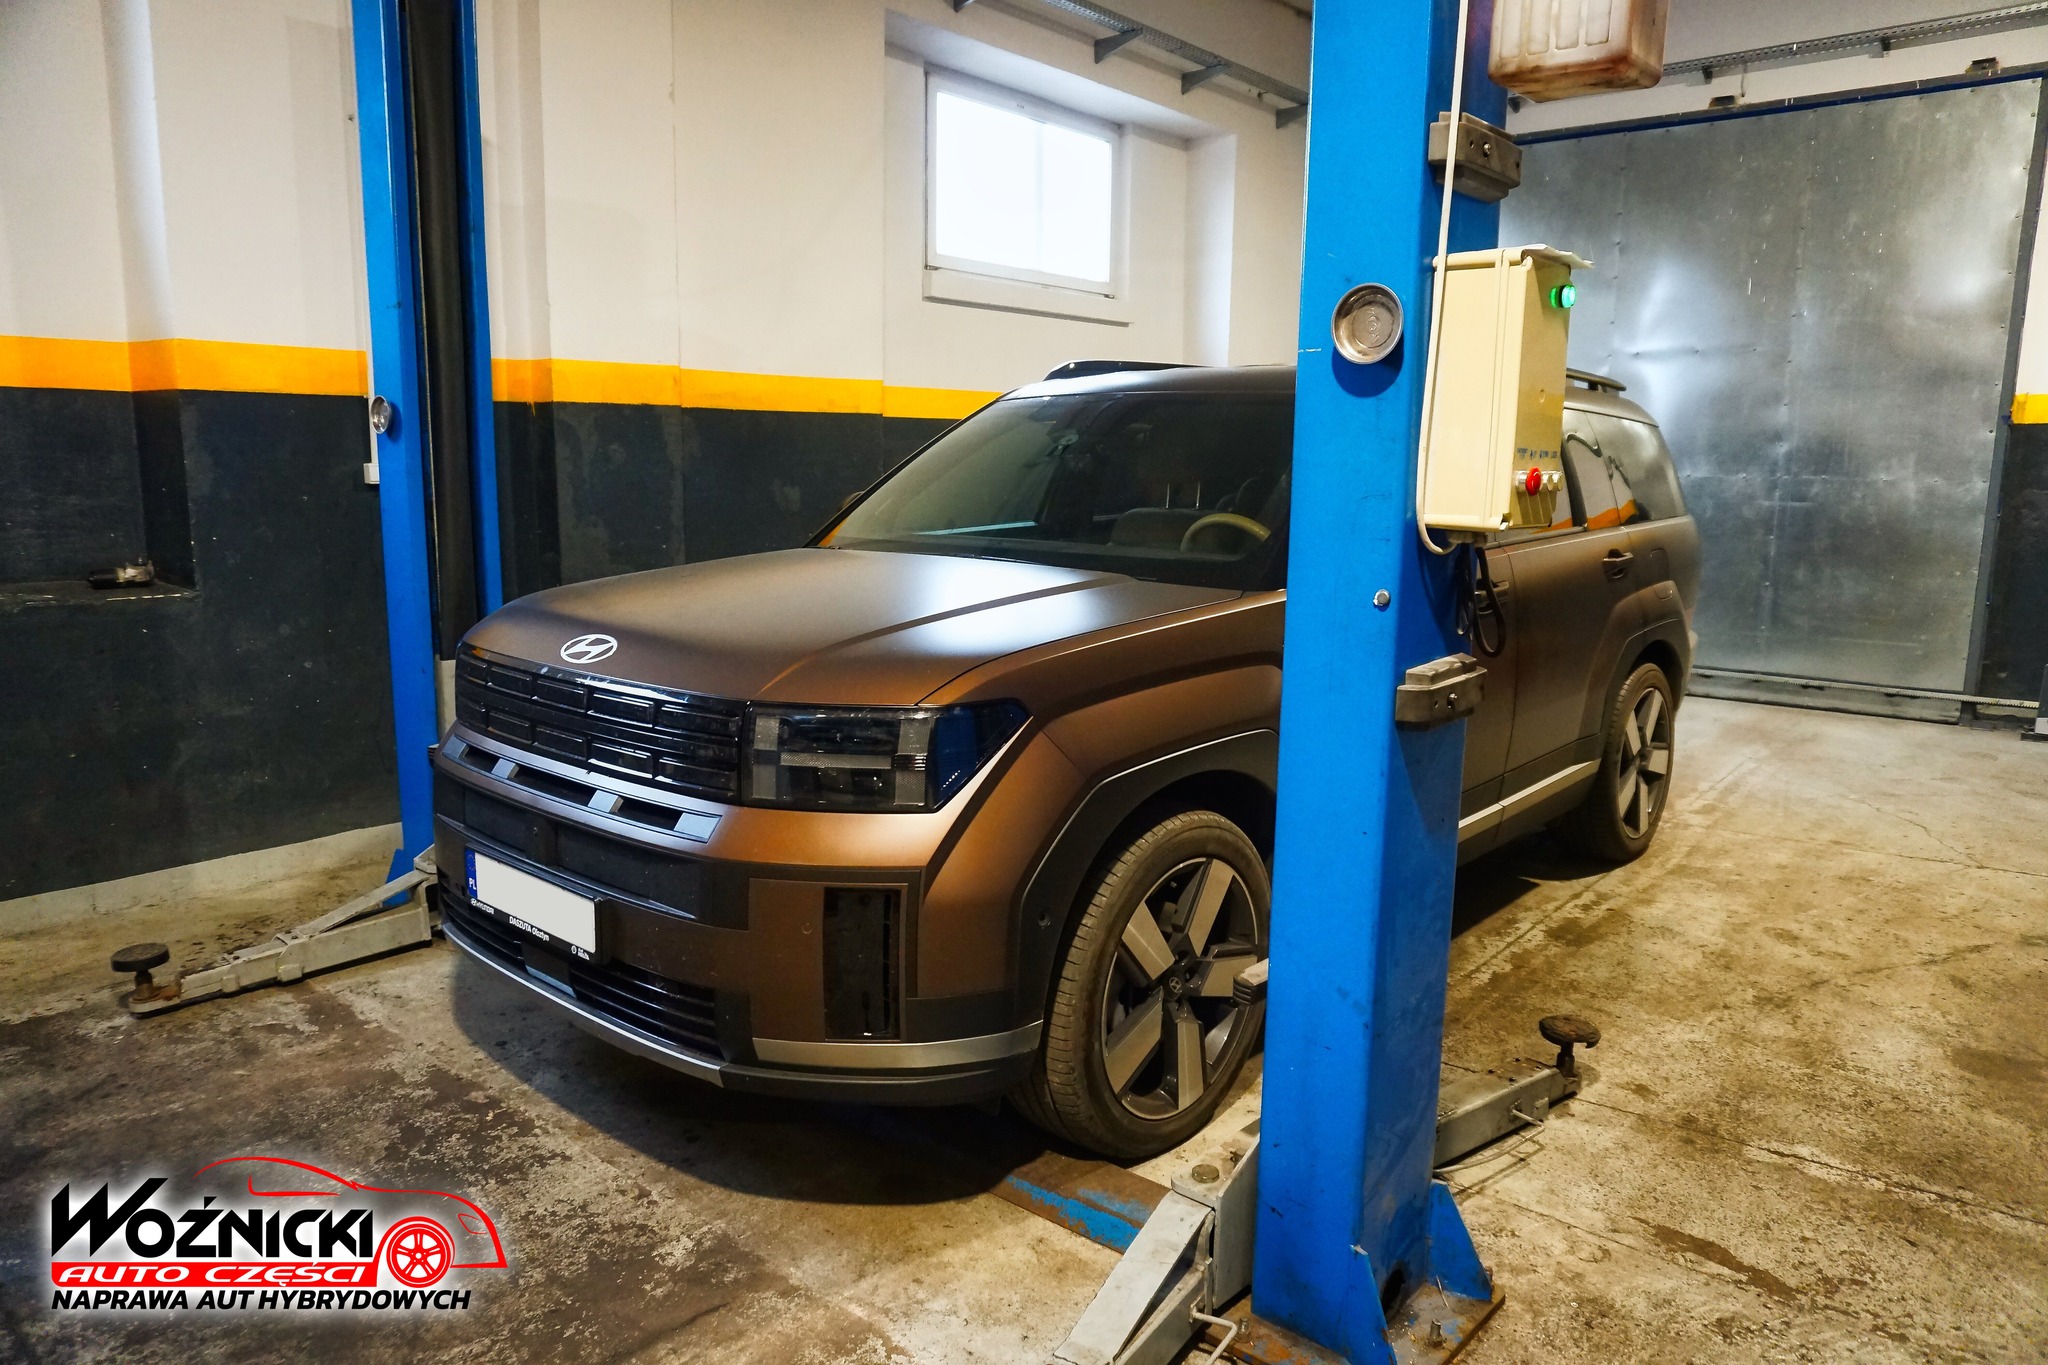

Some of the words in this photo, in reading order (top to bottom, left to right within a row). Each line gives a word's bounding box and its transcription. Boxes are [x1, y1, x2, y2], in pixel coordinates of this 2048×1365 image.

[469, 877, 477, 890] PL
[509, 916, 532, 933] DASZUTA
[532, 927, 550, 942] Olsztyn
